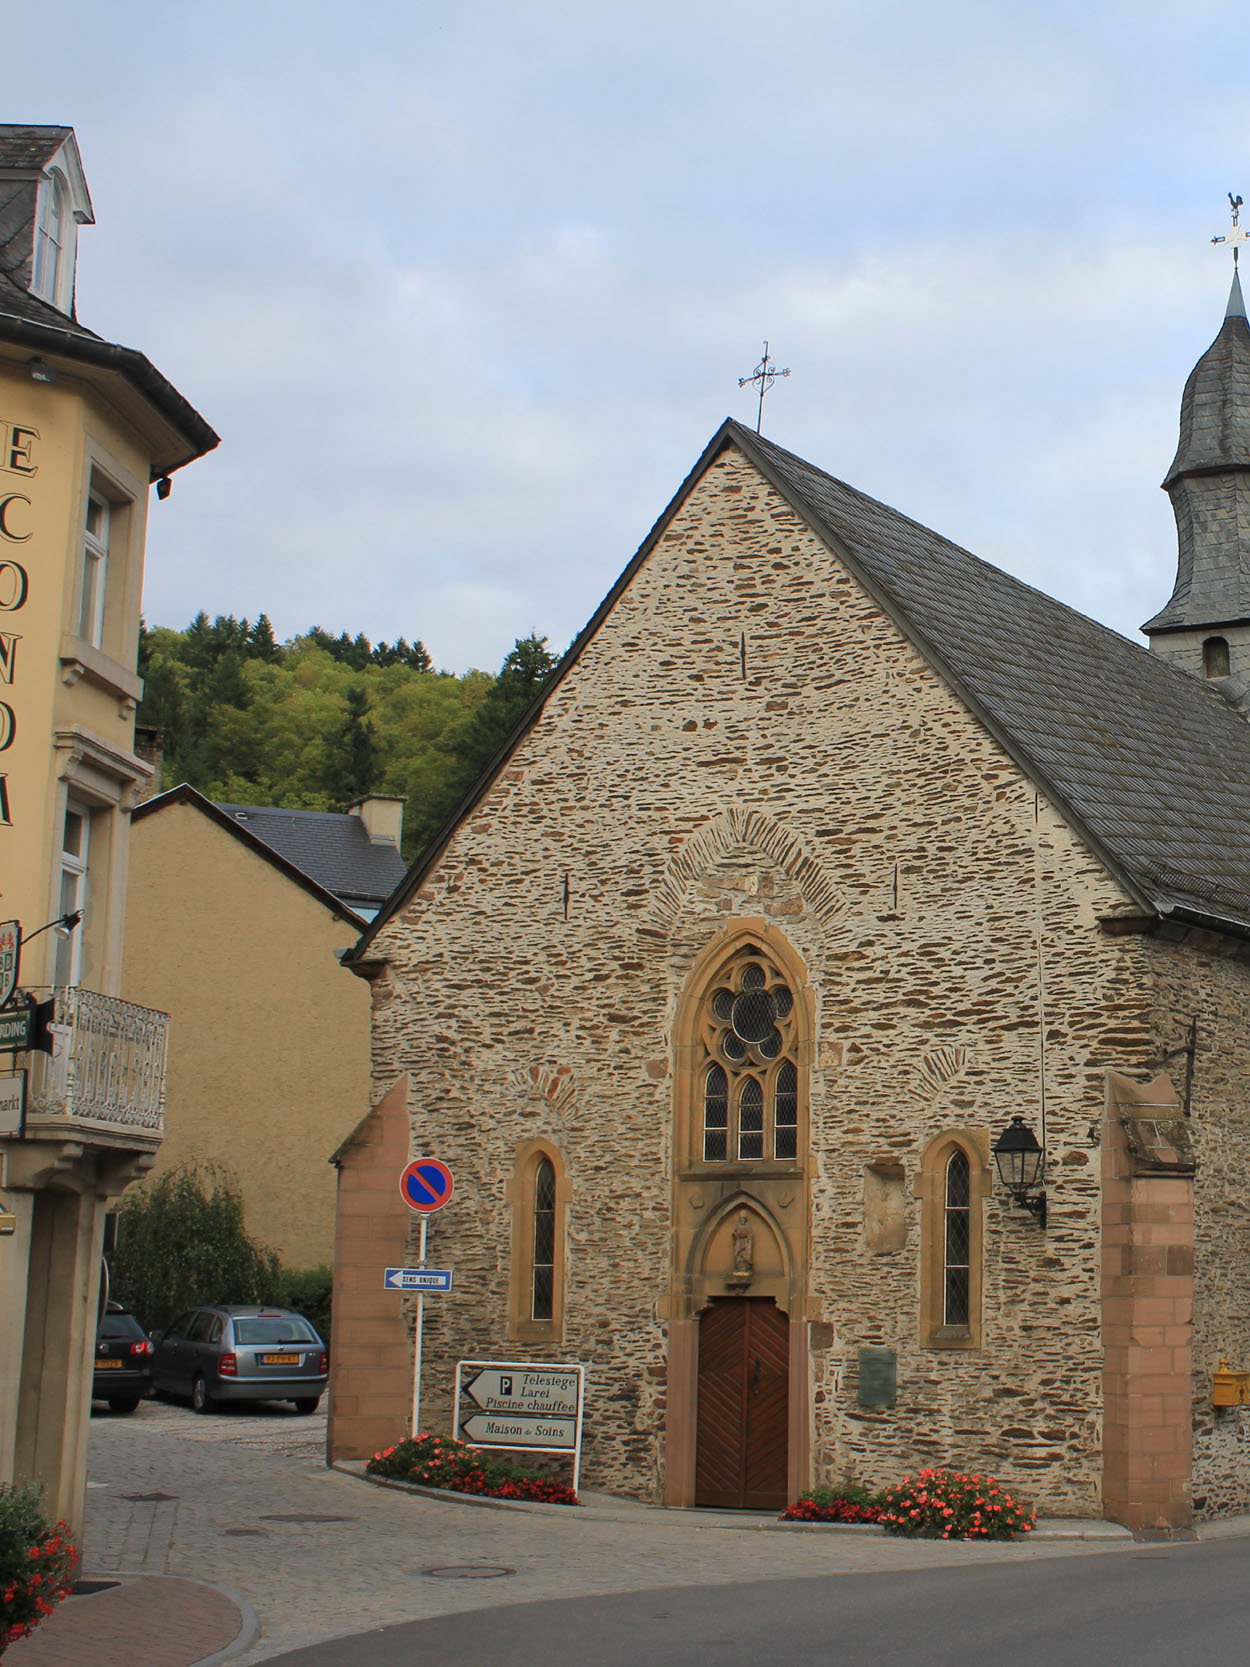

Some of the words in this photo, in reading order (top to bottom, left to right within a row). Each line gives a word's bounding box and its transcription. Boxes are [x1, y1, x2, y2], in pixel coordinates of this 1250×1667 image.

[0, 418, 41, 826] ECON
[486, 1397, 524, 1409] Piscine
[485, 1422, 523, 1435] Maison
[534, 1425, 565, 1437] Soins
